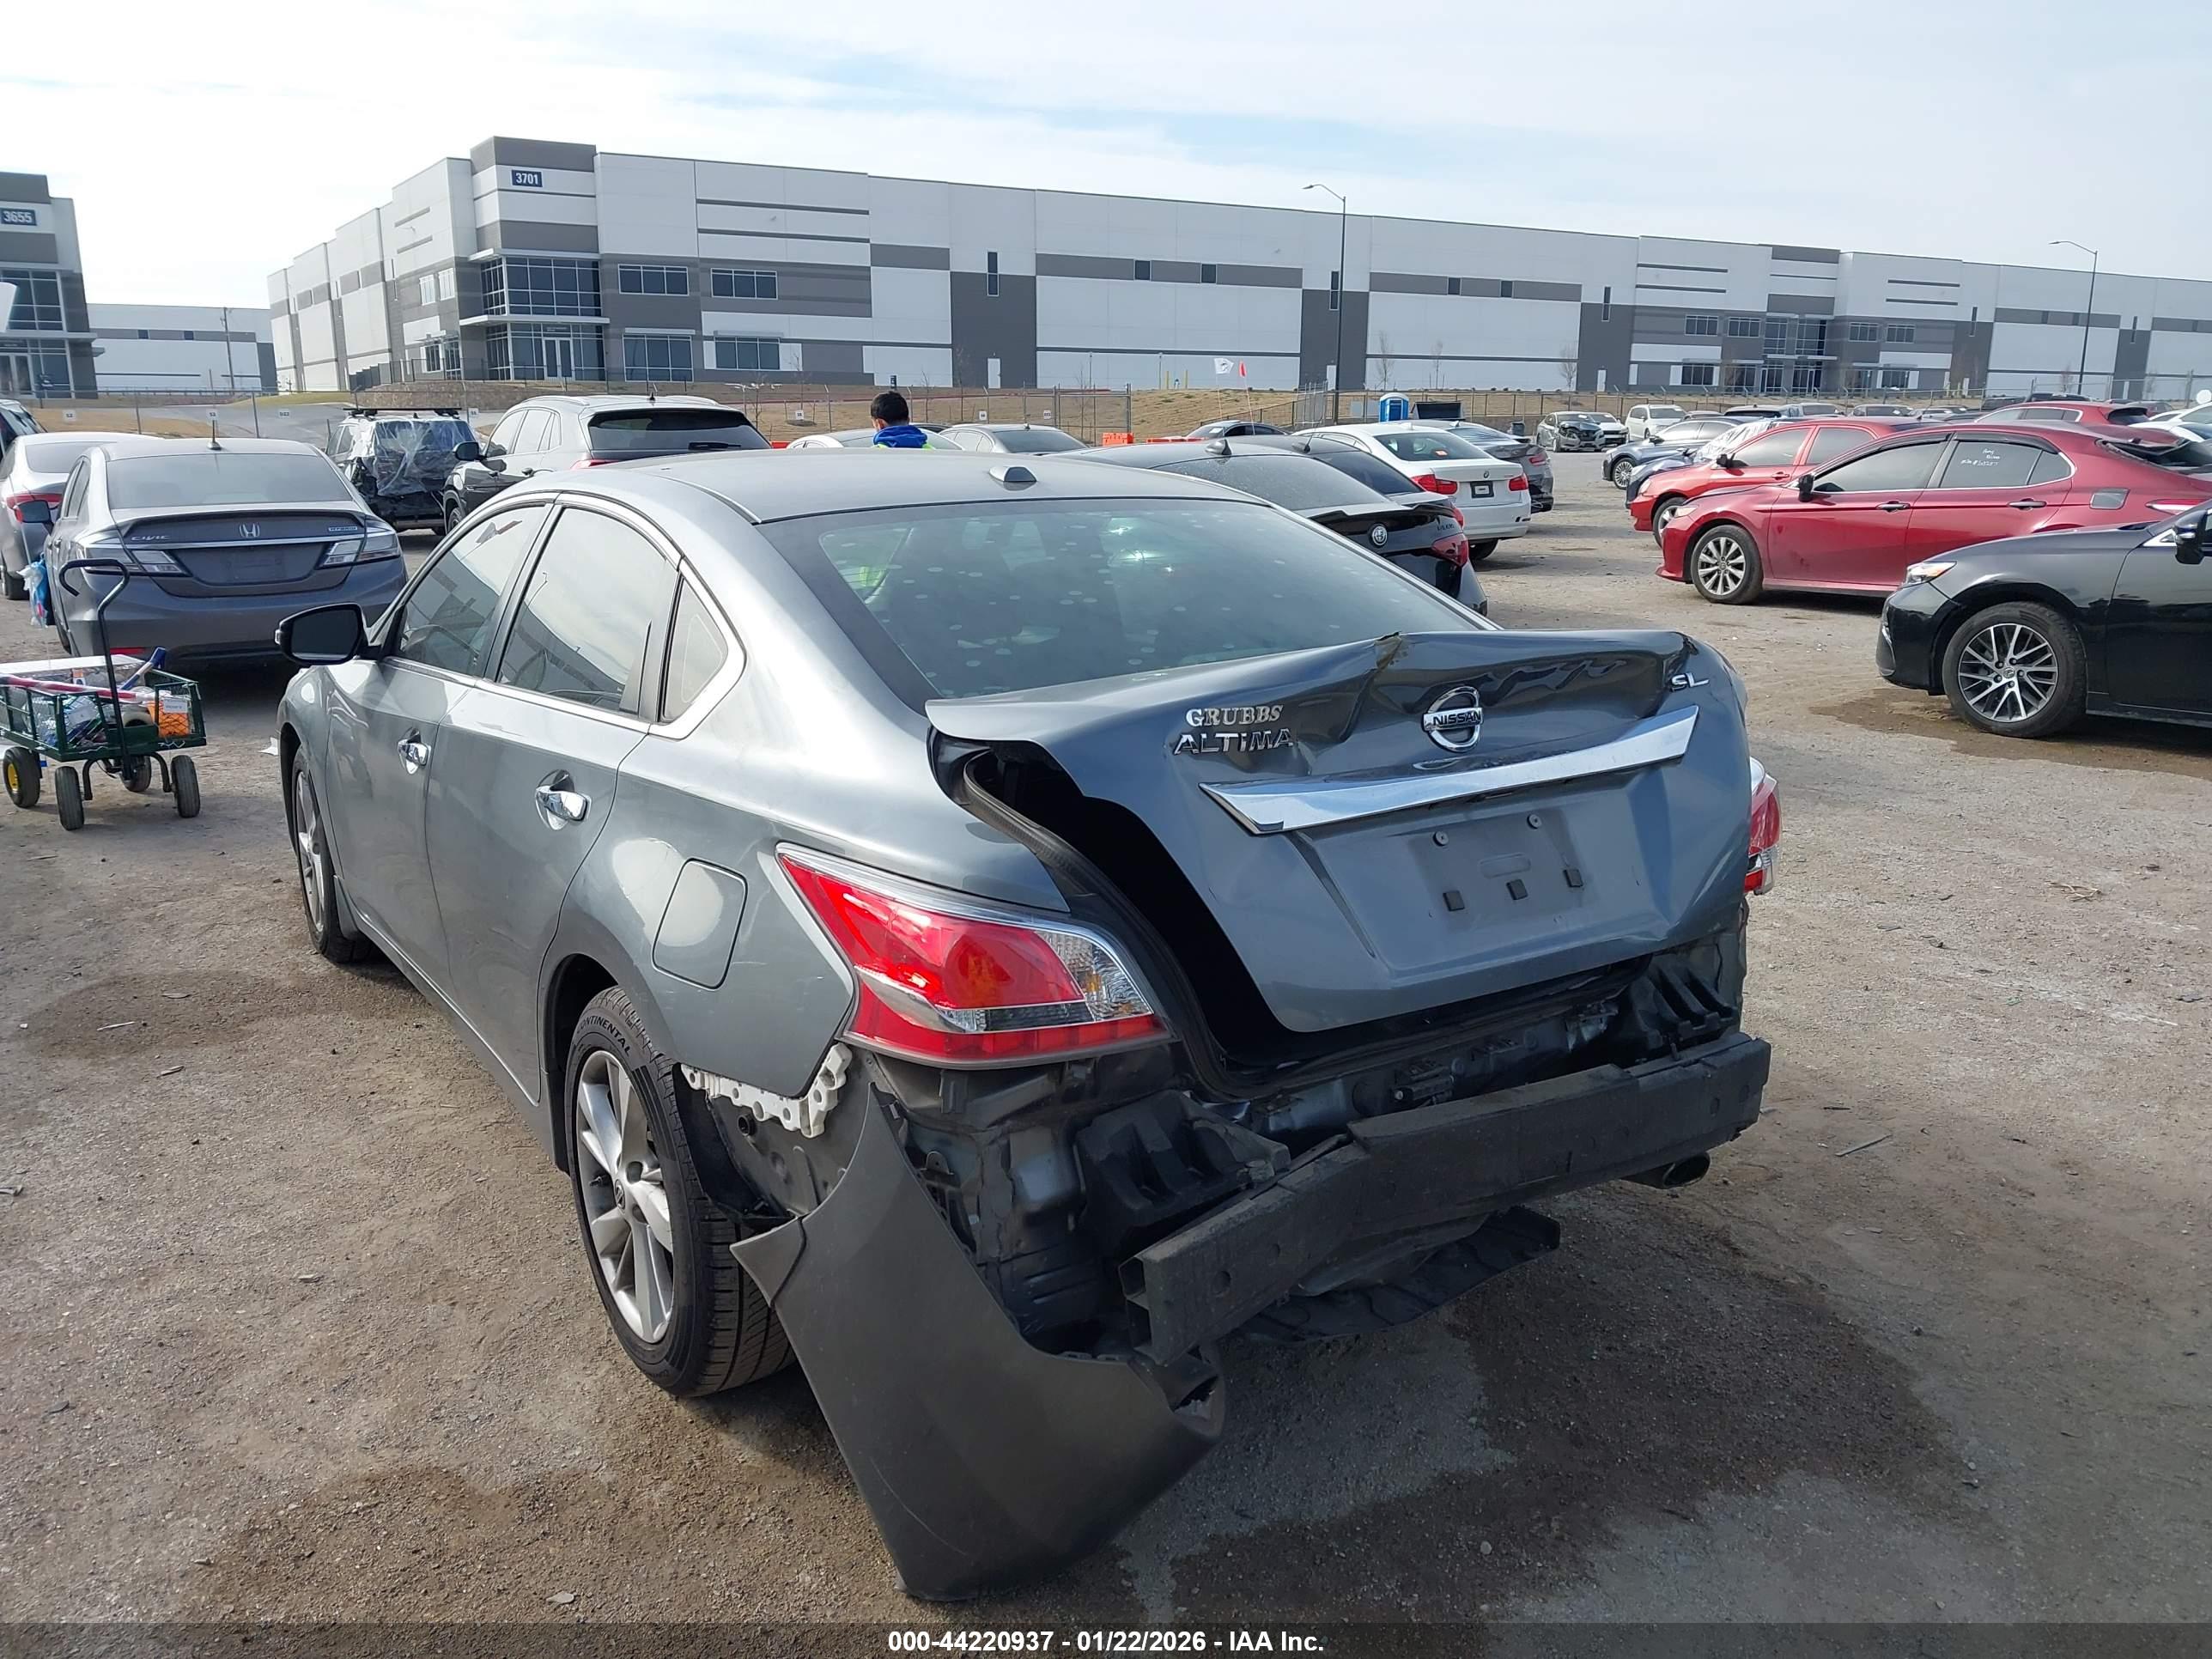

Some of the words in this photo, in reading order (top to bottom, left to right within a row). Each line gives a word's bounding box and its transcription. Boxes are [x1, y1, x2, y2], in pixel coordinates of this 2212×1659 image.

[515, 172, 539, 185] 3701
[3, 210, 33, 223] 3655
[1671, 672, 1711, 691] SL
[1185, 704, 1284, 727] GRUBBS
[1432, 710, 1482, 726] NISSAN
